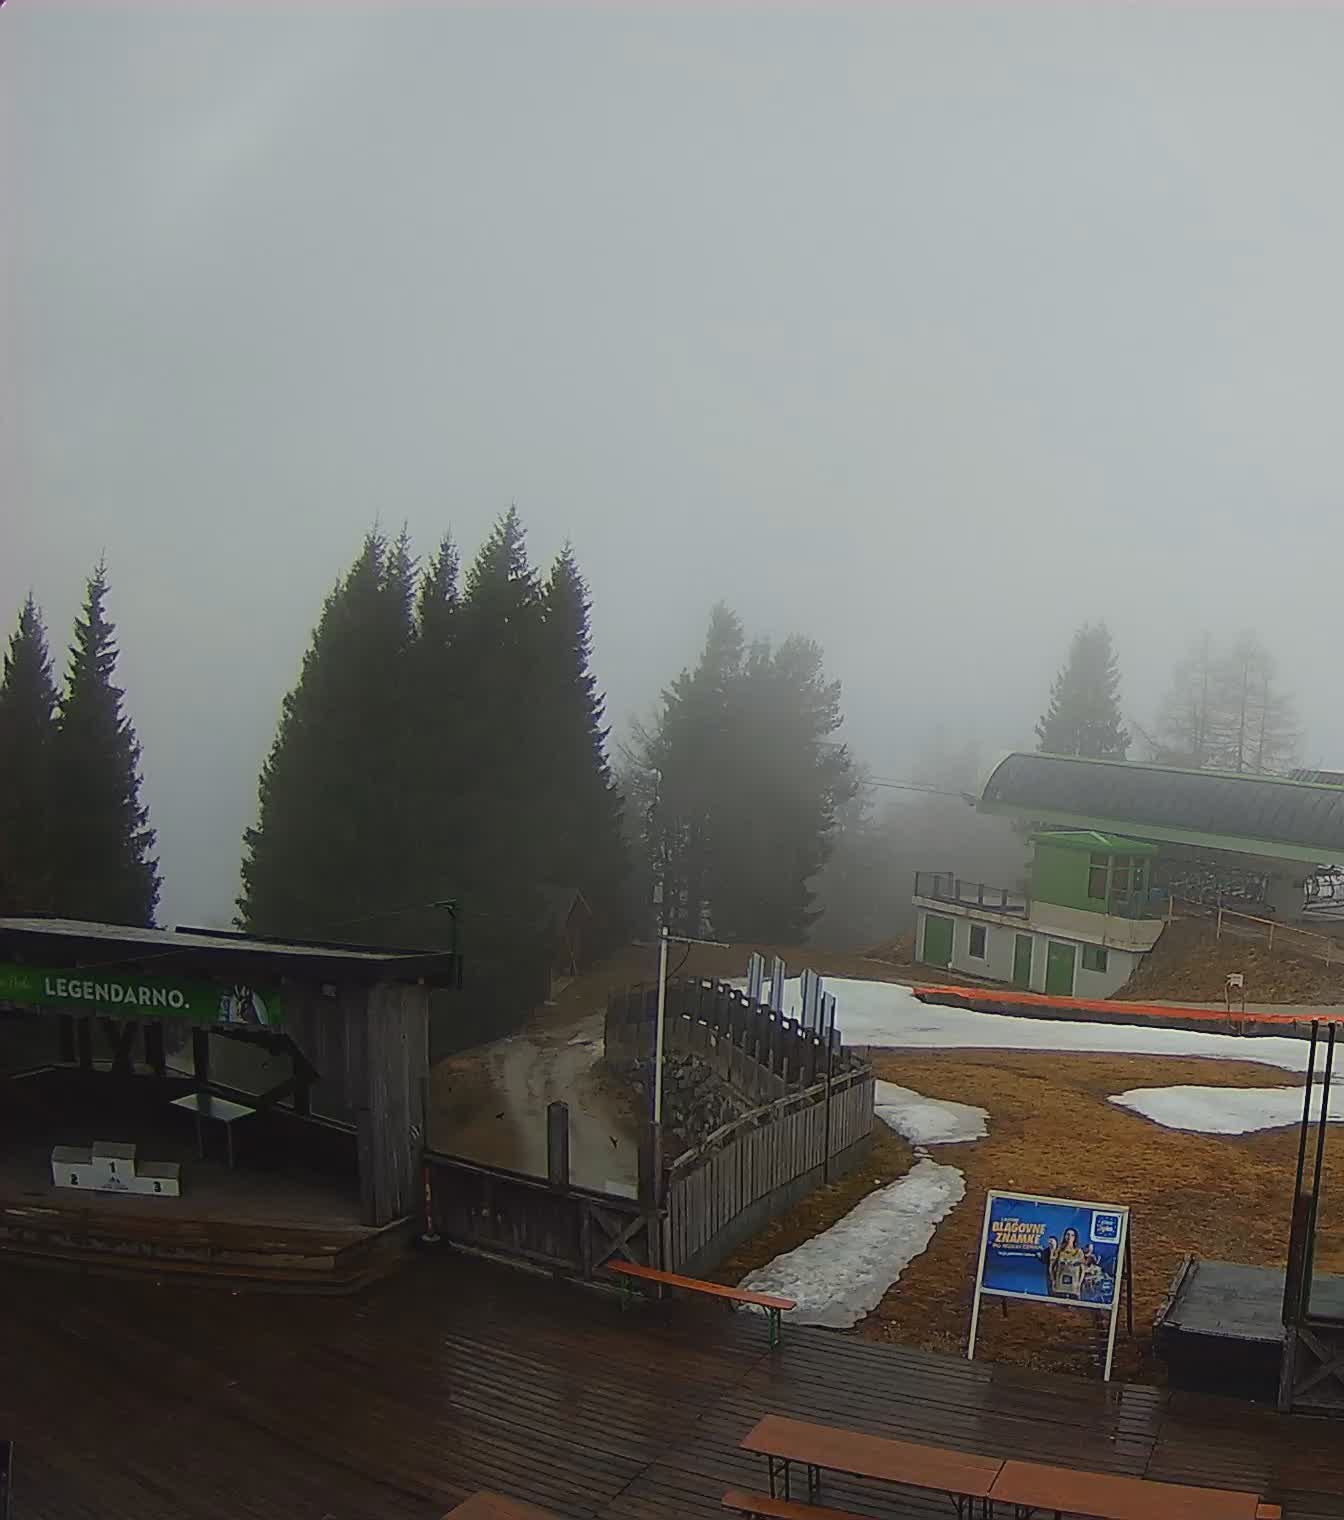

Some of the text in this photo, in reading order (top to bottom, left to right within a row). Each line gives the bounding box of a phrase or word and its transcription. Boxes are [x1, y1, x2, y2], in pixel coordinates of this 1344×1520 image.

[44, 977, 190, 1009] LEGENDARNO.
[109, 1161, 116, 1173] 1
[70, 1173, 78, 1185] 2
[153, 1181, 162, 1193] 3
[992, 1221, 1047, 1235] BLAGOVNE
[994, 1231, 1041, 1246] ZNAMKE
